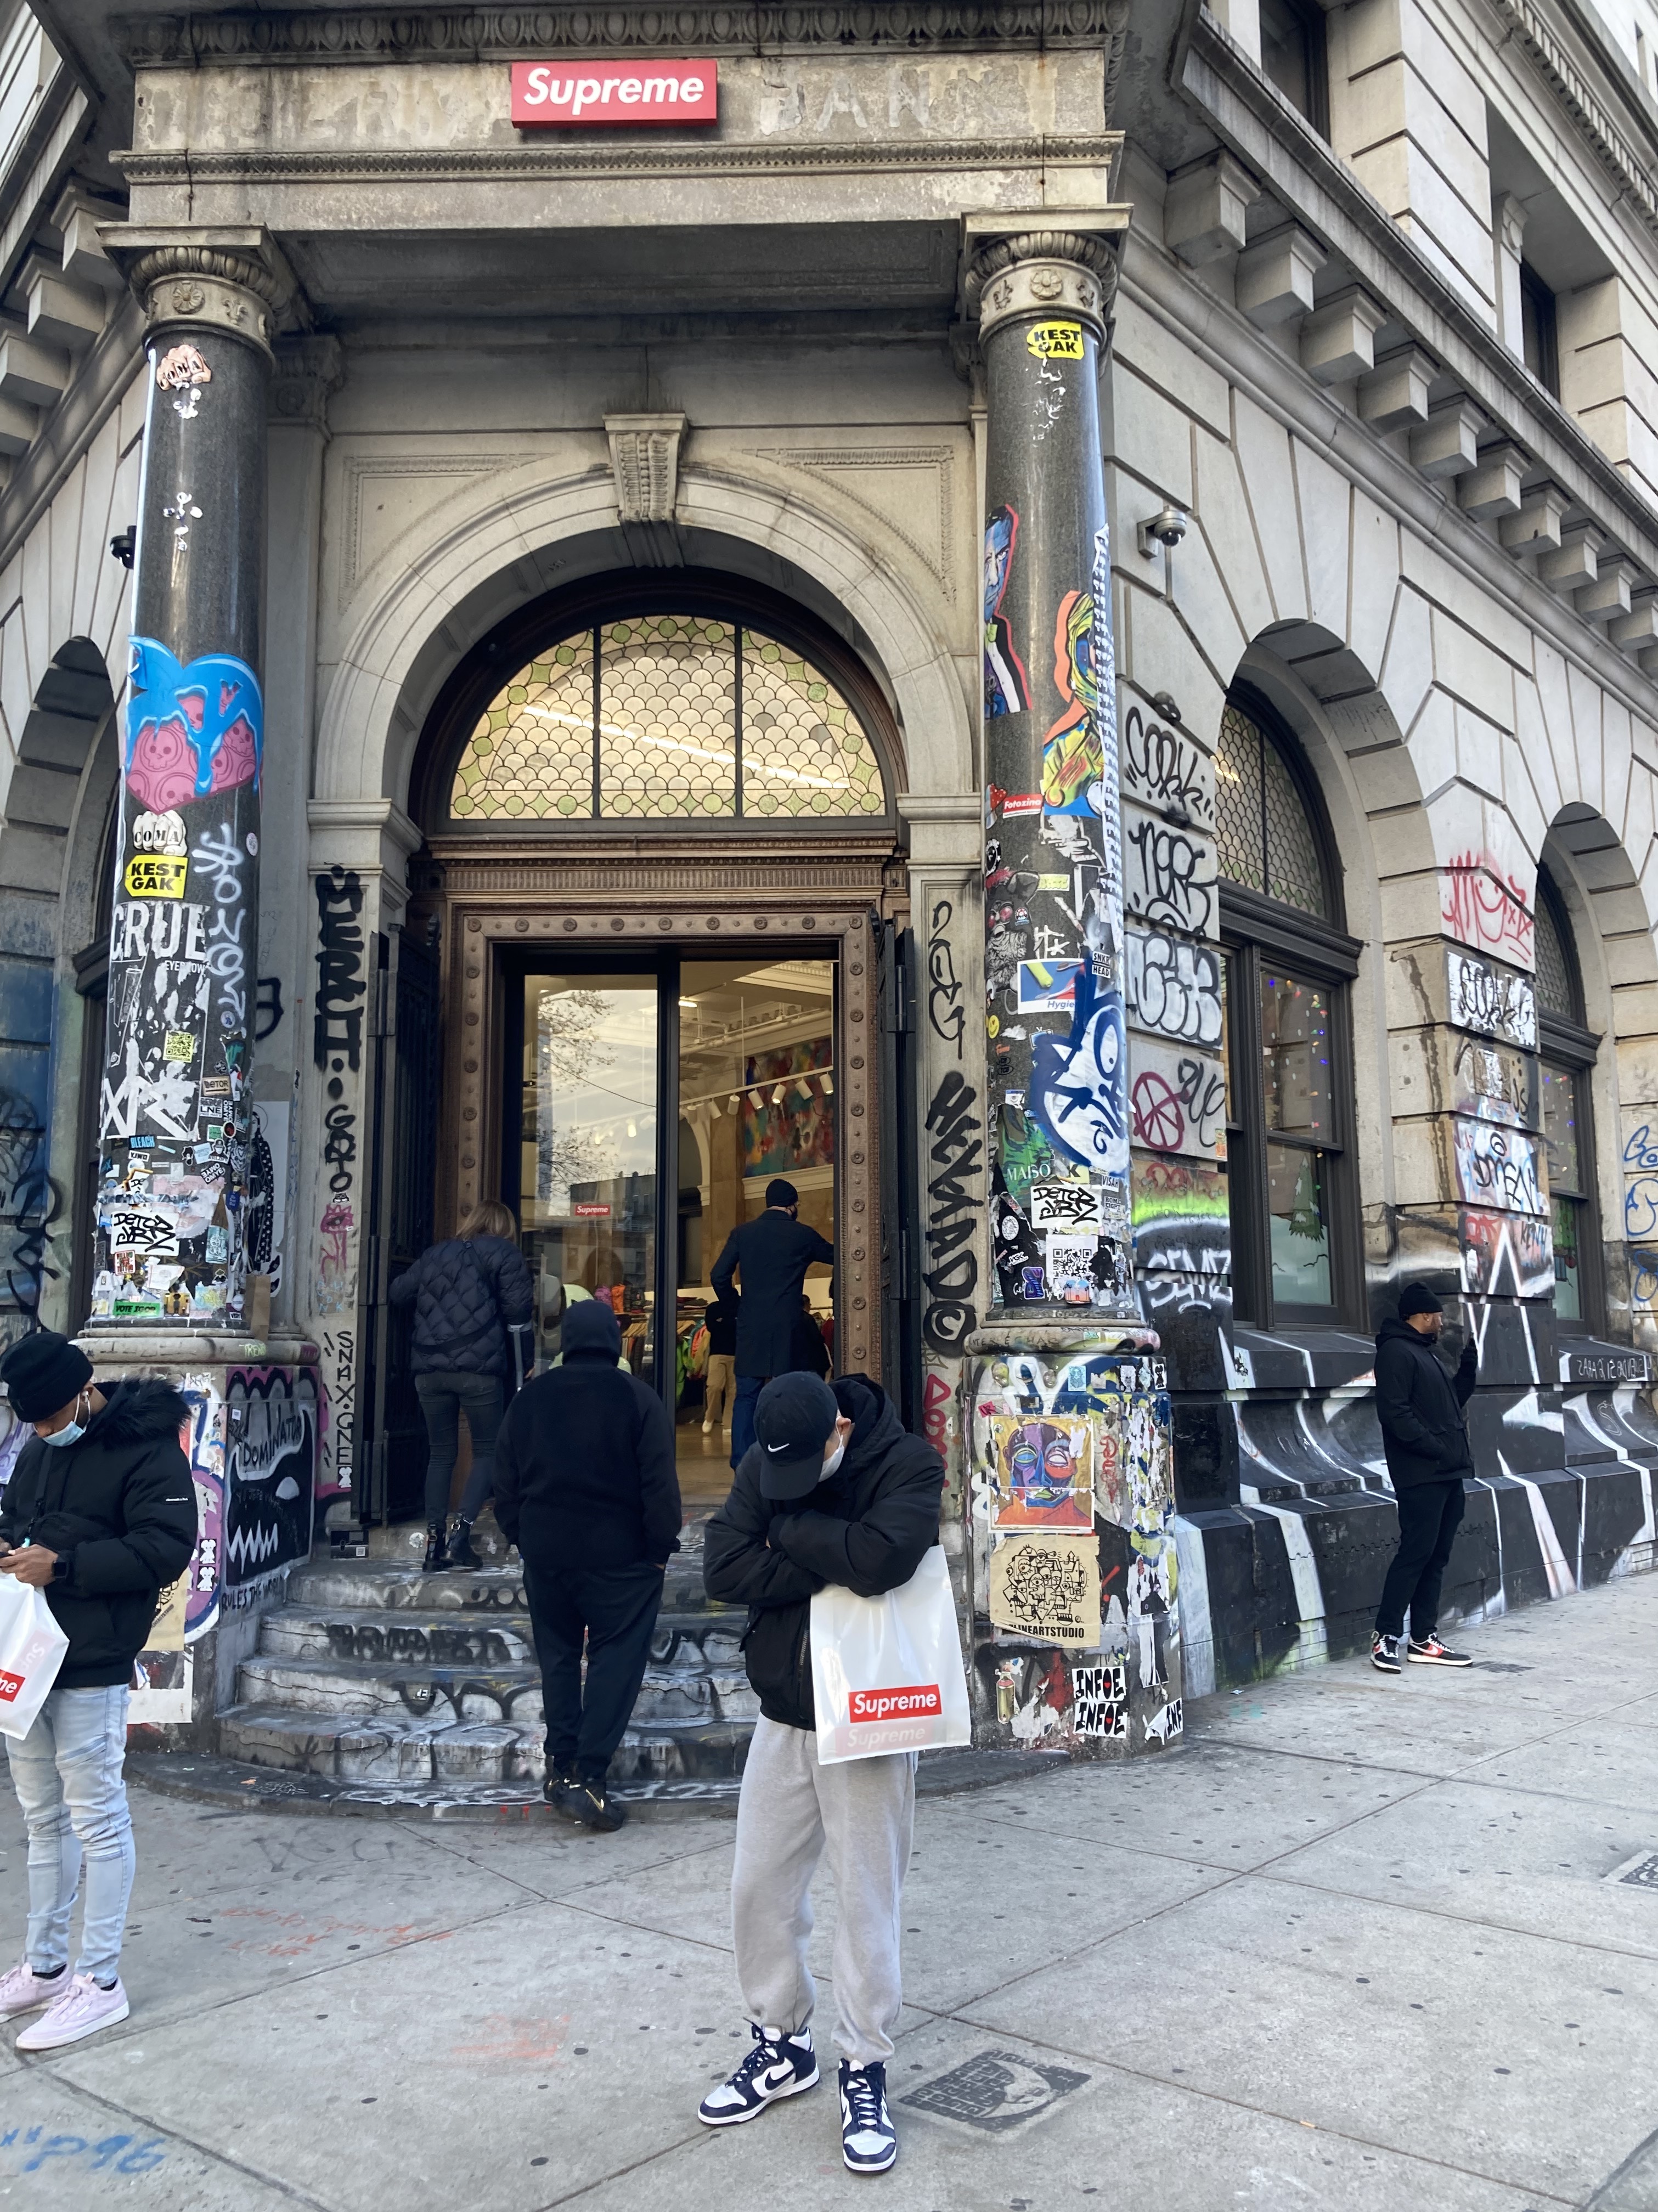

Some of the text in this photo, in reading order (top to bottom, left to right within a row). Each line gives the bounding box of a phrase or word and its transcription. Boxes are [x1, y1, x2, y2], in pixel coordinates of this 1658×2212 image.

[523, 67, 704, 116] Supreme
[1034, 329, 1080, 342] KEST
[134, 830, 180, 843] COMA
[131, 862, 185, 878] KEST
[131, 877, 175, 891] GAK
[1093, 966, 1109, 977] HEAD
[130, 1136, 155, 1148] BLEACH
[577, 1205, 608, 1215] Supreme
[853, 1692, 938, 1718] Supreme
[847, 1726, 926, 1749] Supreme
